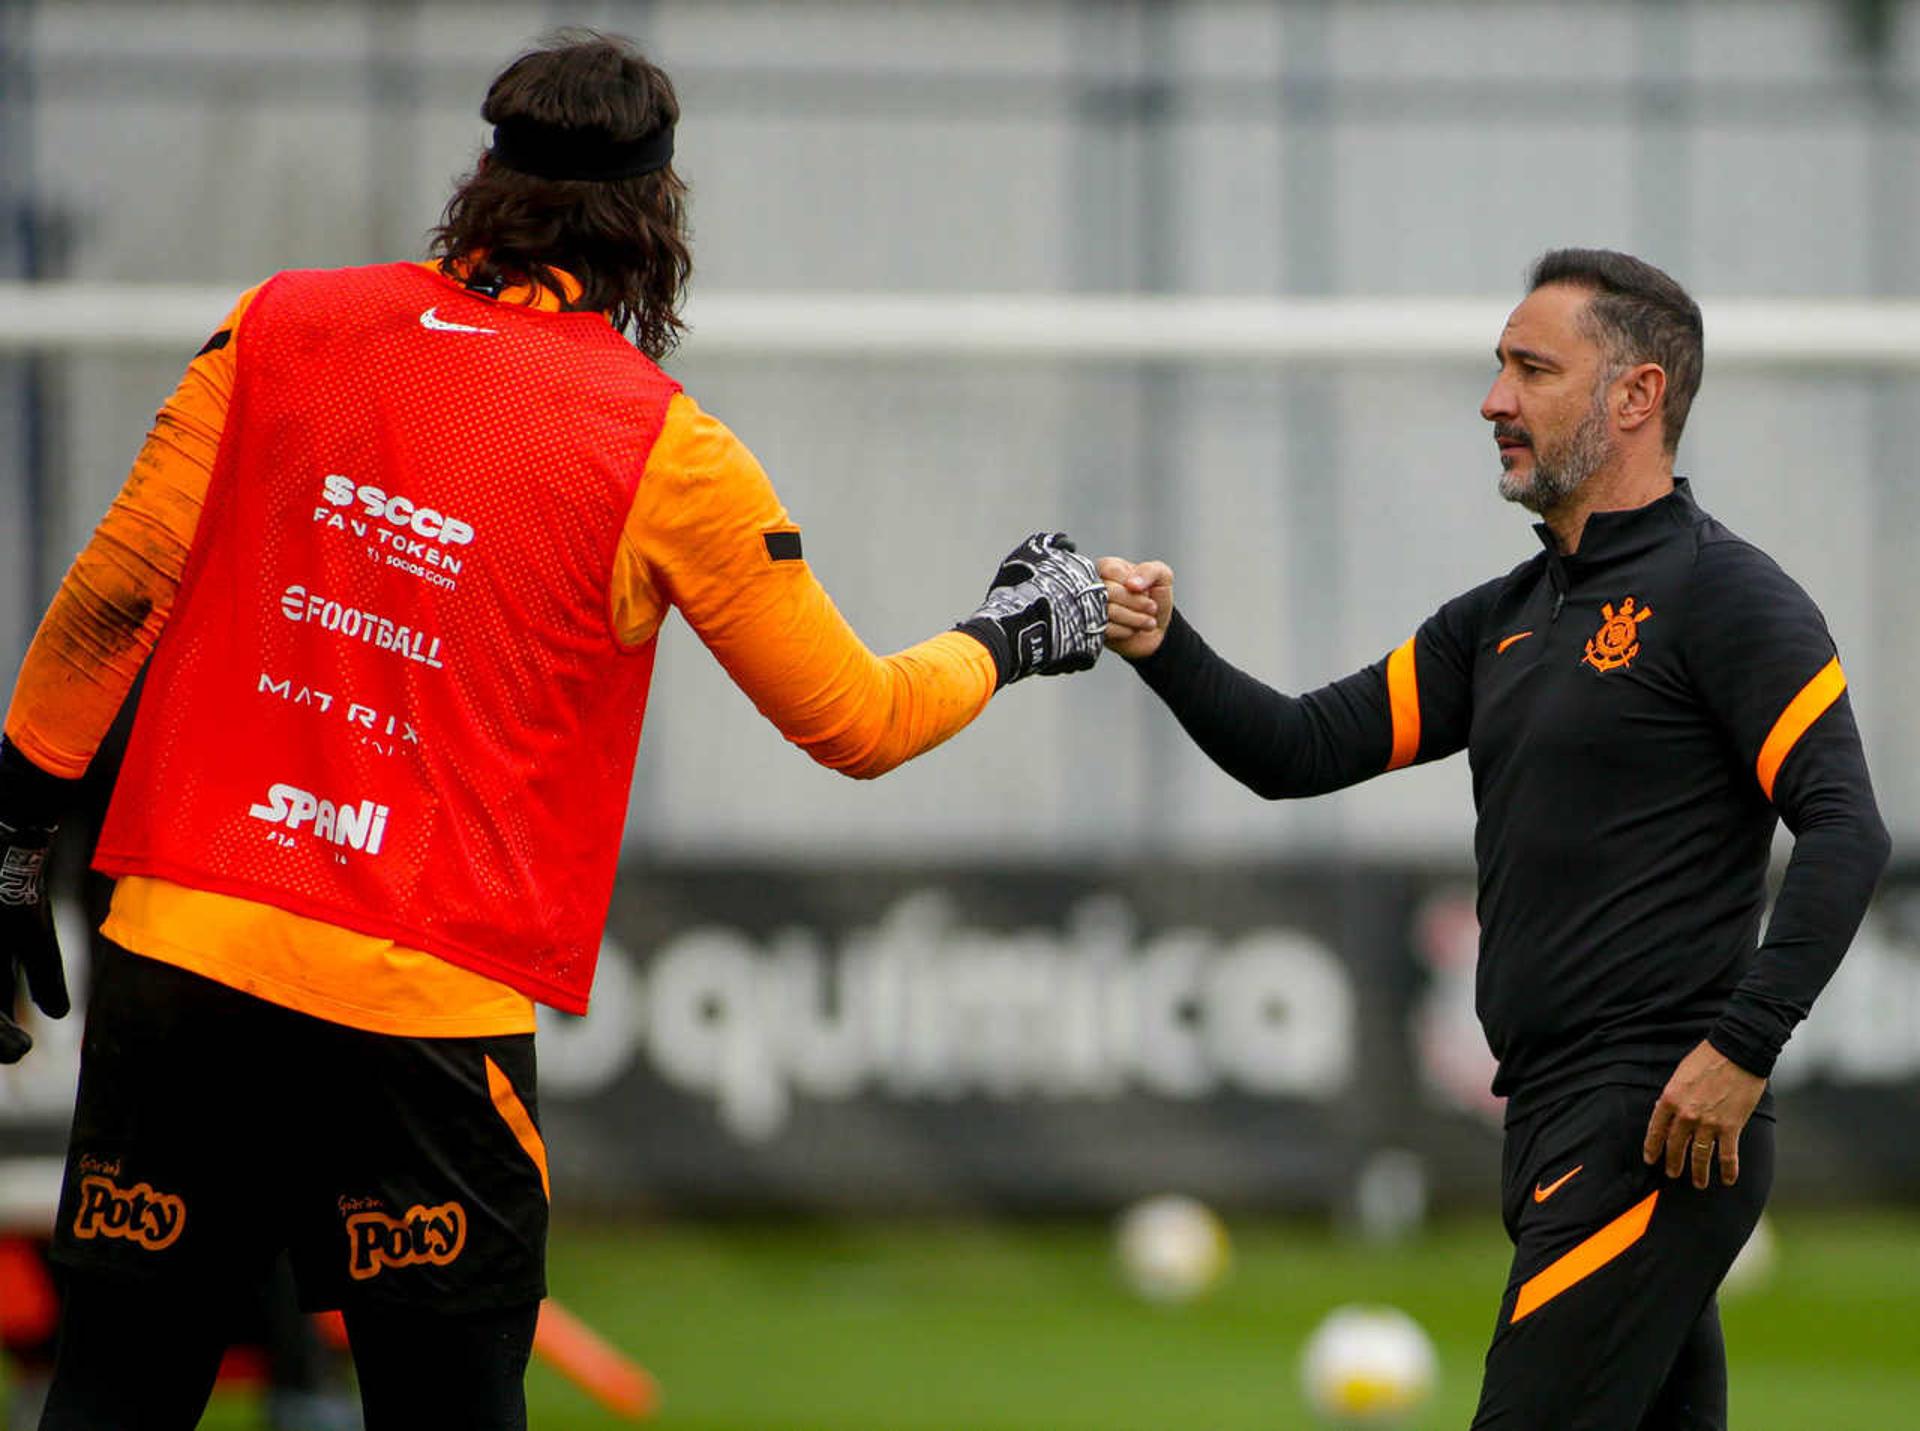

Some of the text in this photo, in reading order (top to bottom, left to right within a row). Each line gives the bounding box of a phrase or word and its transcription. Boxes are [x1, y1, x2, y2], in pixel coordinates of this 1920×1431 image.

[377, 527, 463, 575] TOKEN
[257, 673, 420, 745] MATRIX
[77, 1180, 181, 1246] Poty
[350, 1207, 463, 1275] Poty
